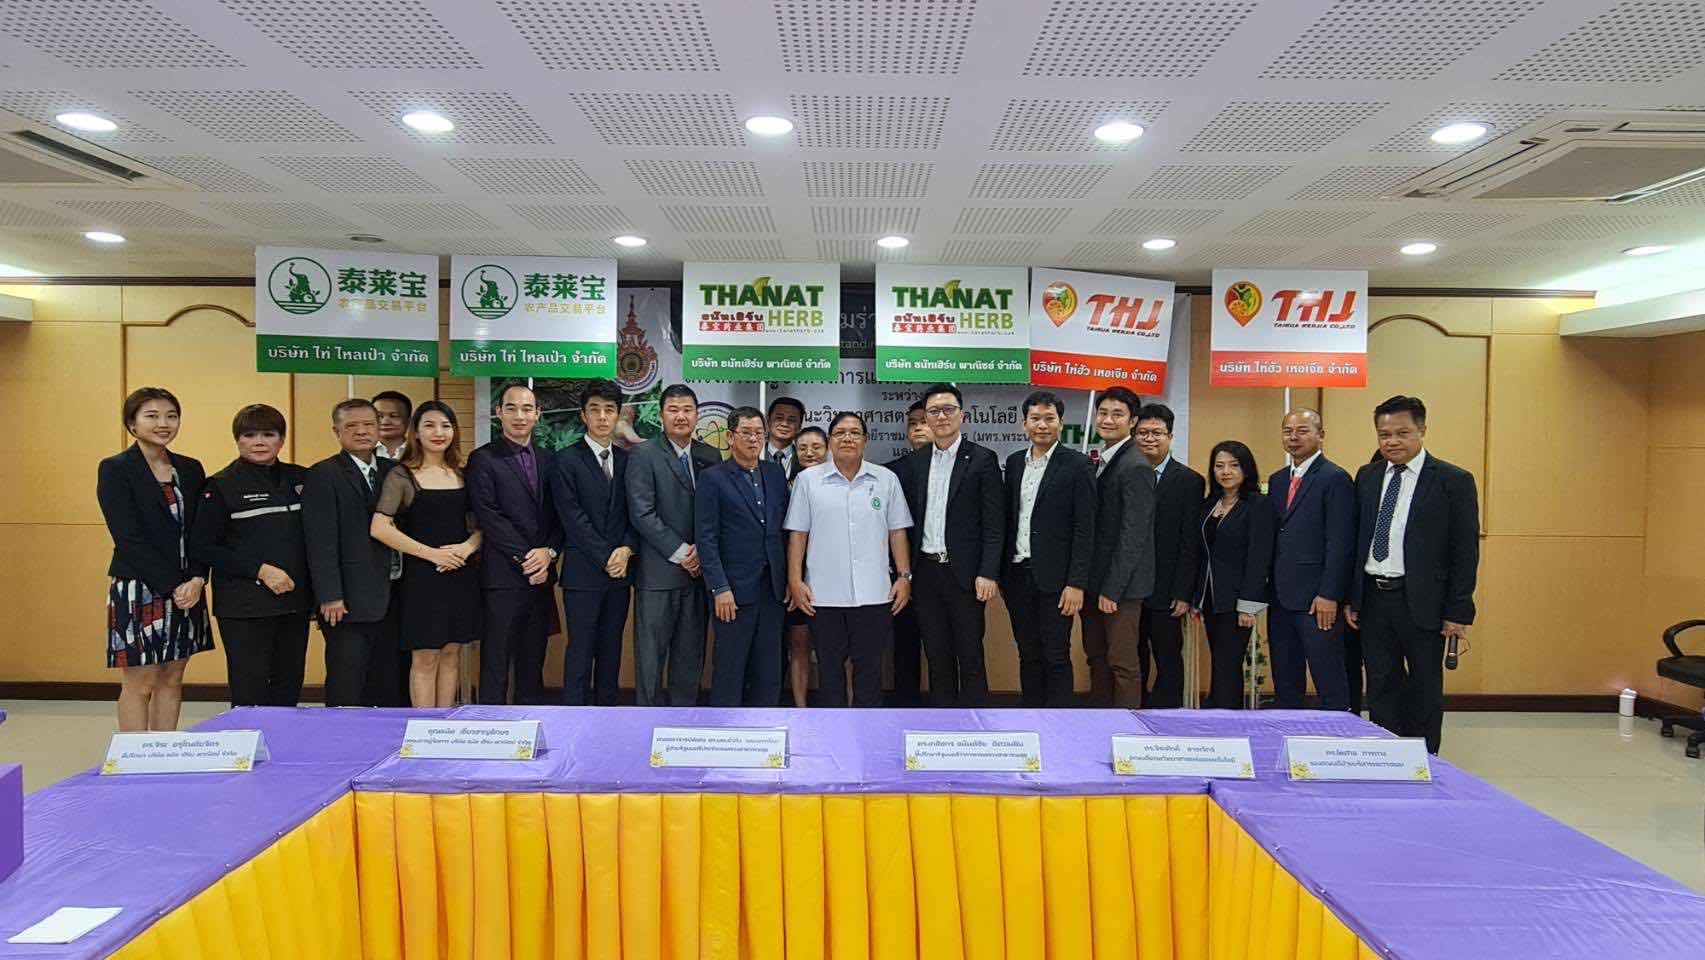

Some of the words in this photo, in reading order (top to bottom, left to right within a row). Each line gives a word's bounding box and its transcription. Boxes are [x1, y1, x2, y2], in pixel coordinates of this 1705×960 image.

[337, 267, 428, 298] 泰莱宝
[523, 273, 606, 300] 泰莱宝
[699, 284, 824, 307] THANAT
[892, 286, 1013, 310] THANAT
[767, 309, 824, 327] HERB
[959, 311, 1013, 329] HERB
[1086, 294, 1164, 331] THJ
[268, 345, 309, 360] บริษัท
[391, 347, 429, 363] จำกัด
[459, 350, 497, 363] บริษัท
[572, 350, 608, 365] จำกัด
[691, 358, 718, 368] บริษัท
[805, 359, 832, 369] จำกัด
[885, 359, 912, 369] บริษัท
[998, 360, 1023, 370] จำกัด
[1032, 361, 1061, 374] บริษัท
[1131, 369, 1158, 382] จำกัด
[1219, 361, 1250, 373] บริษัท
[1328, 362, 1358, 374] จำกัด
